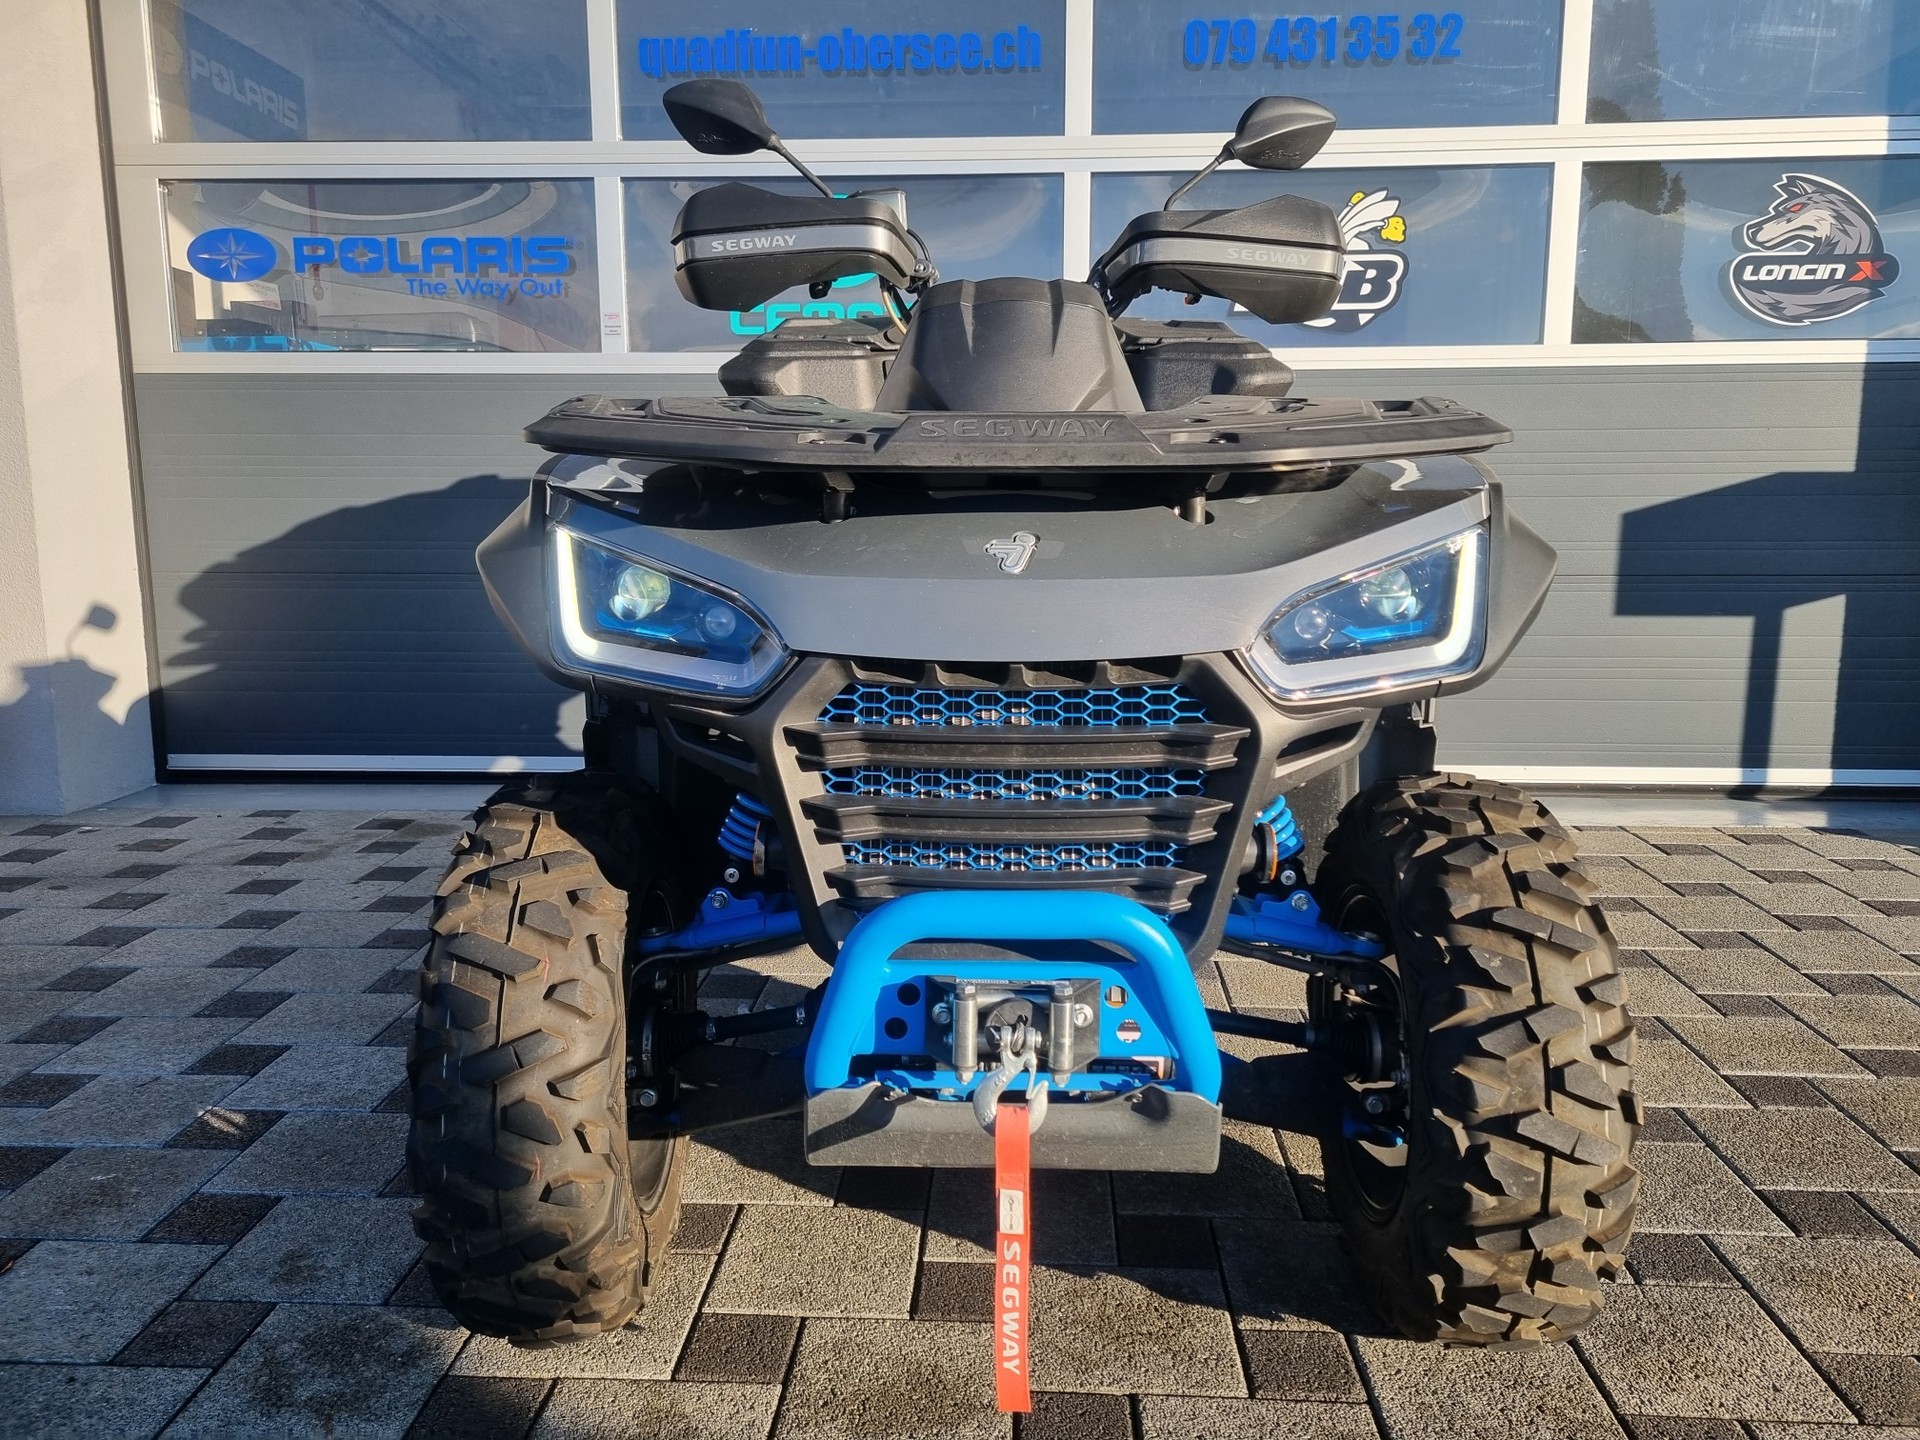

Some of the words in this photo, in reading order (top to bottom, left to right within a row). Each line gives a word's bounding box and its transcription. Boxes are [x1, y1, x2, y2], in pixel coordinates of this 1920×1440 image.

[638, 25, 1042, 77] quadfun-obersee.ch
[1183, 19, 1257, 65] 079
[1266, 16, 1338, 62] 431
[1348, 15, 1401, 60] 35
[1411, 12, 1465, 58] 32
[189, 48, 299, 130] POLARIS
[292, 236, 570, 274] POLARIS
[711, 234, 797, 252] SEGWAY
[1226, 247, 1312, 266] SEGWAY
[1742, 263, 1846, 281] LONCIN
[405, 278, 448, 297] The
[455, 278, 511, 301] Way
[518, 278, 566, 297] Out
[920, 418, 1115, 438] SEGWAY
[1002, 1239, 1021, 1376] SEGWAY
